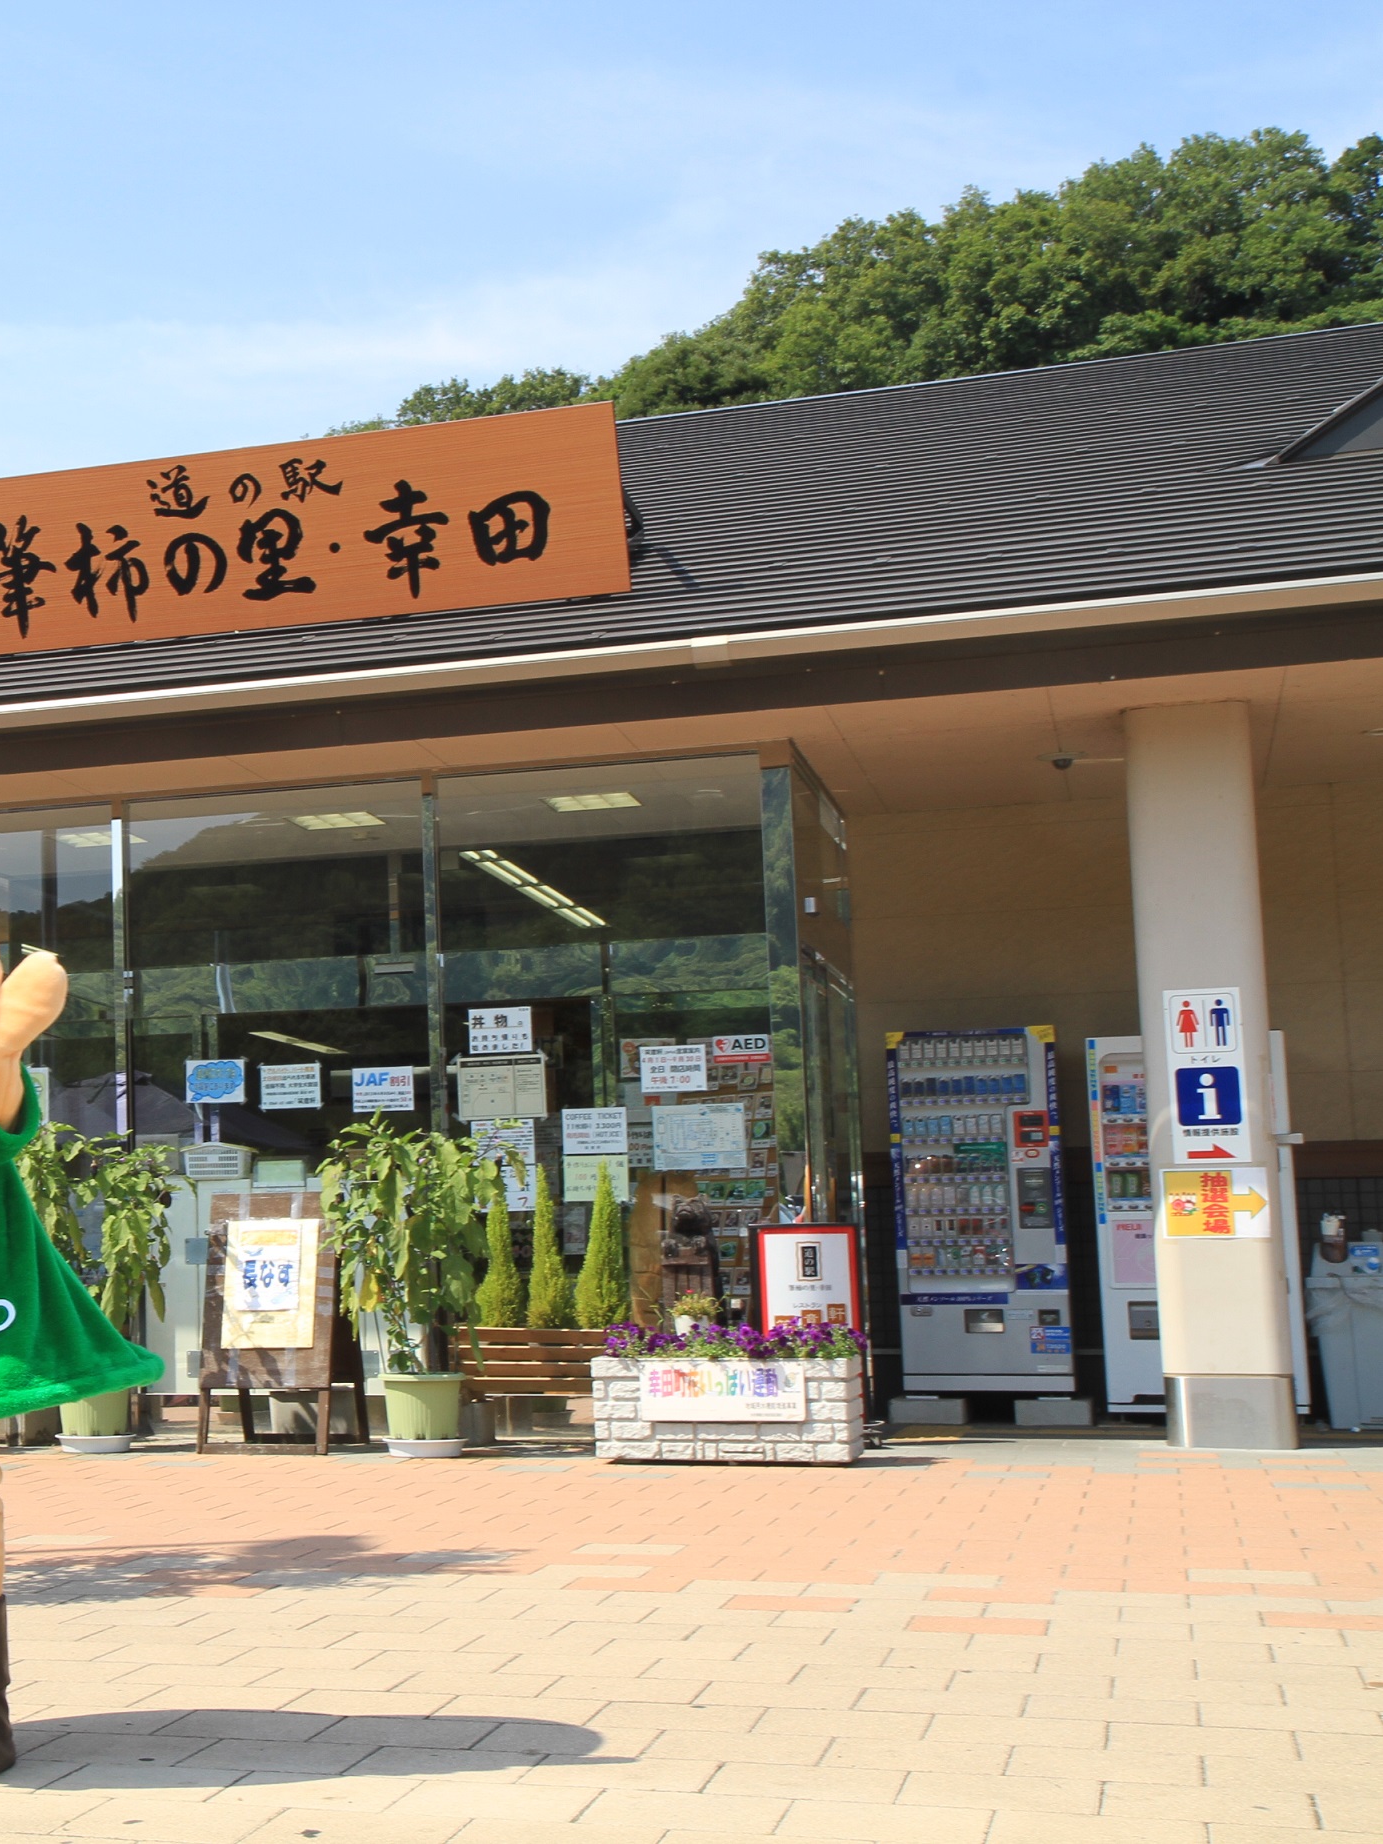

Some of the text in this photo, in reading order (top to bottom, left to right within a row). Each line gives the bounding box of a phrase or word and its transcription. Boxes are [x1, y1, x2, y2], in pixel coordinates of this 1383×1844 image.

[146, 457, 343, 519] 道の駅
[731, 1038, 766, 1050] AED
[1190, 1056, 1221, 1064] トイレ
[354, 1072, 389, 1086] JAF
[597, 1112, 623, 1120] TICKET
[1183, 1128, 1239, 1137] 情報提供施設
[1200, 1172, 1232, 1235] 抽選会場
[804, 1248, 815, 1275] 道の駅
